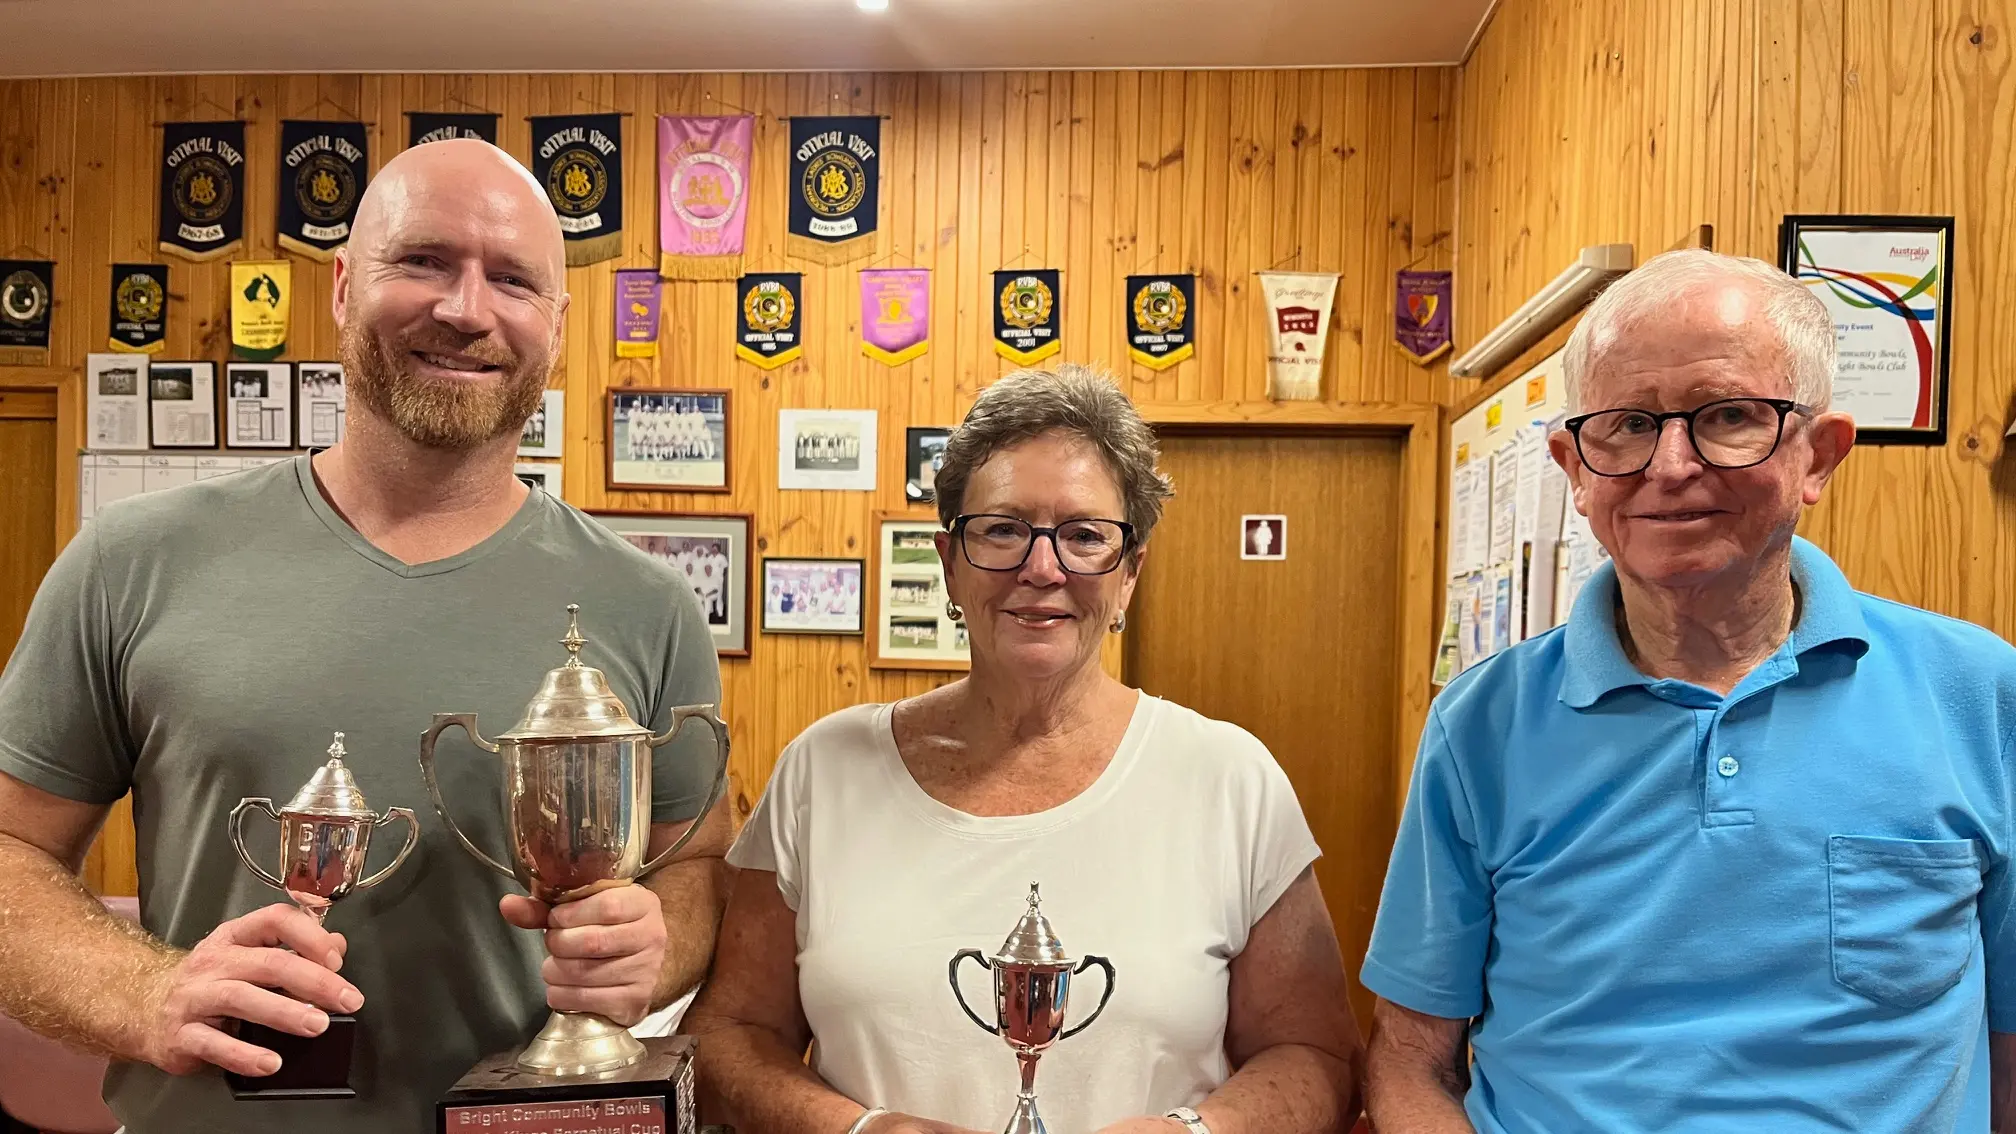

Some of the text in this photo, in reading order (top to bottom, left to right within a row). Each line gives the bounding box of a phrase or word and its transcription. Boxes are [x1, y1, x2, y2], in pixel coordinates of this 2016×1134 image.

[540, 127, 617, 159] OFFICIAL VISIT
[796, 131, 876, 162] OFFICIAL VISIT
[166, 137, 244, 168] OFFICIAL VISIT
[286, 135, 363, 167] OFFICIAL VISIT
[1890, 246, 1930, 256] Australia
[1150, 282, 1170, 292] RVBA
[745, 333, 794, 342] OFFICIAL VISIT
[1002, 328, 1052, 338] OFFICIAL VISIT
[1134, 334, 1184, 344] OFFICIAL VISIT
[1886, 361, 1907, 372] Club
[460, 1101, 651, 1126] Bright Community Bowls
